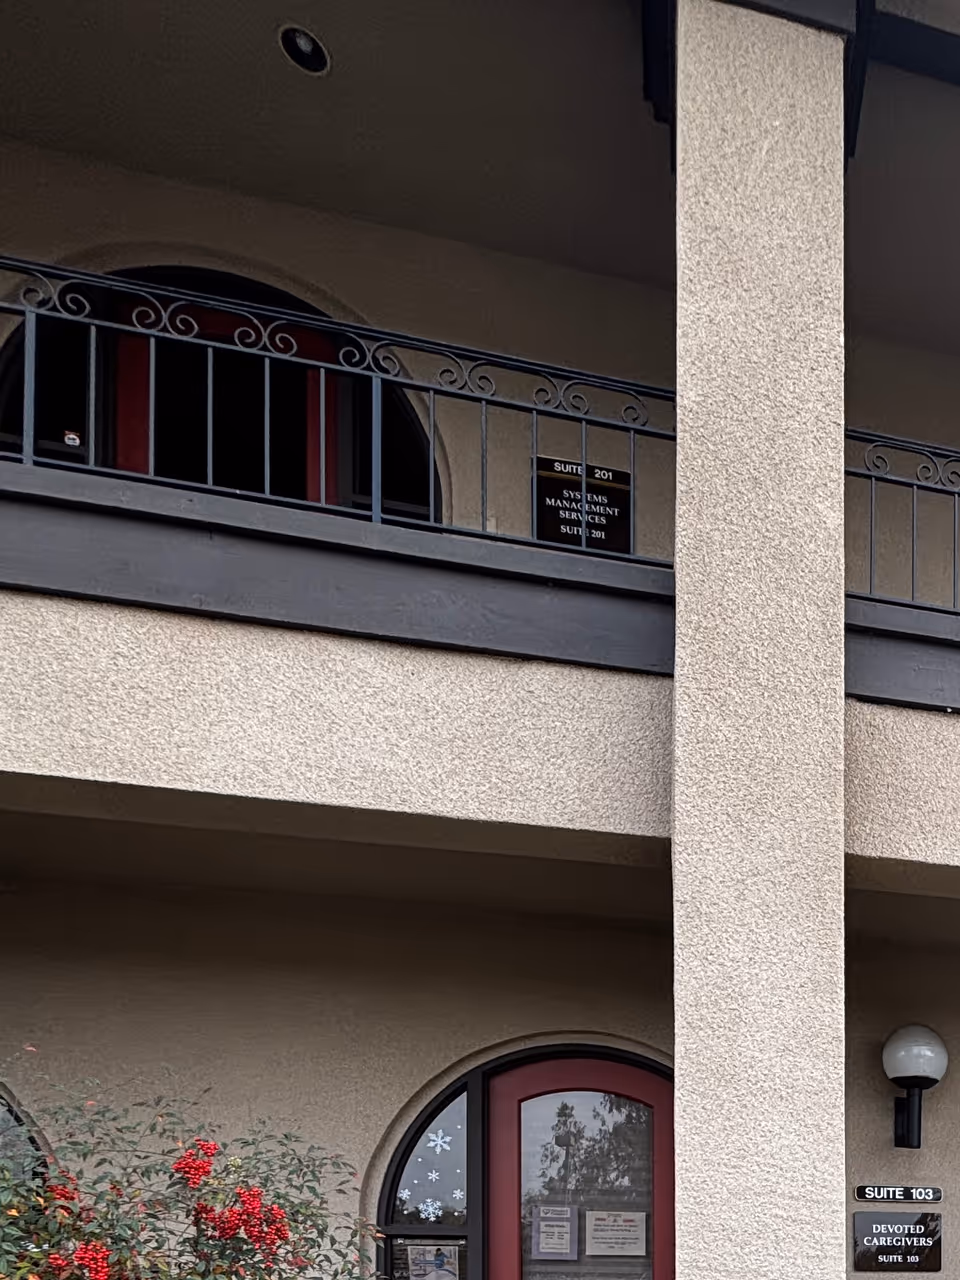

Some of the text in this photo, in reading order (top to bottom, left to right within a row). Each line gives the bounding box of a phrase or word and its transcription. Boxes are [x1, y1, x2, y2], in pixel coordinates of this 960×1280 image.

[553, 462, 613, 480] SUITE 201
[563, 489, 608, 504] SYSEMS
[591, 530, 606, 539] 201
[864, 1187, 934, 1200] SUITE 103
[872, 1224, 925, 1234] DEVOTED
[863, 1236, 933, 1247] CAREGIVERS
[878, 1254, 919, 1263] SUITE 103
